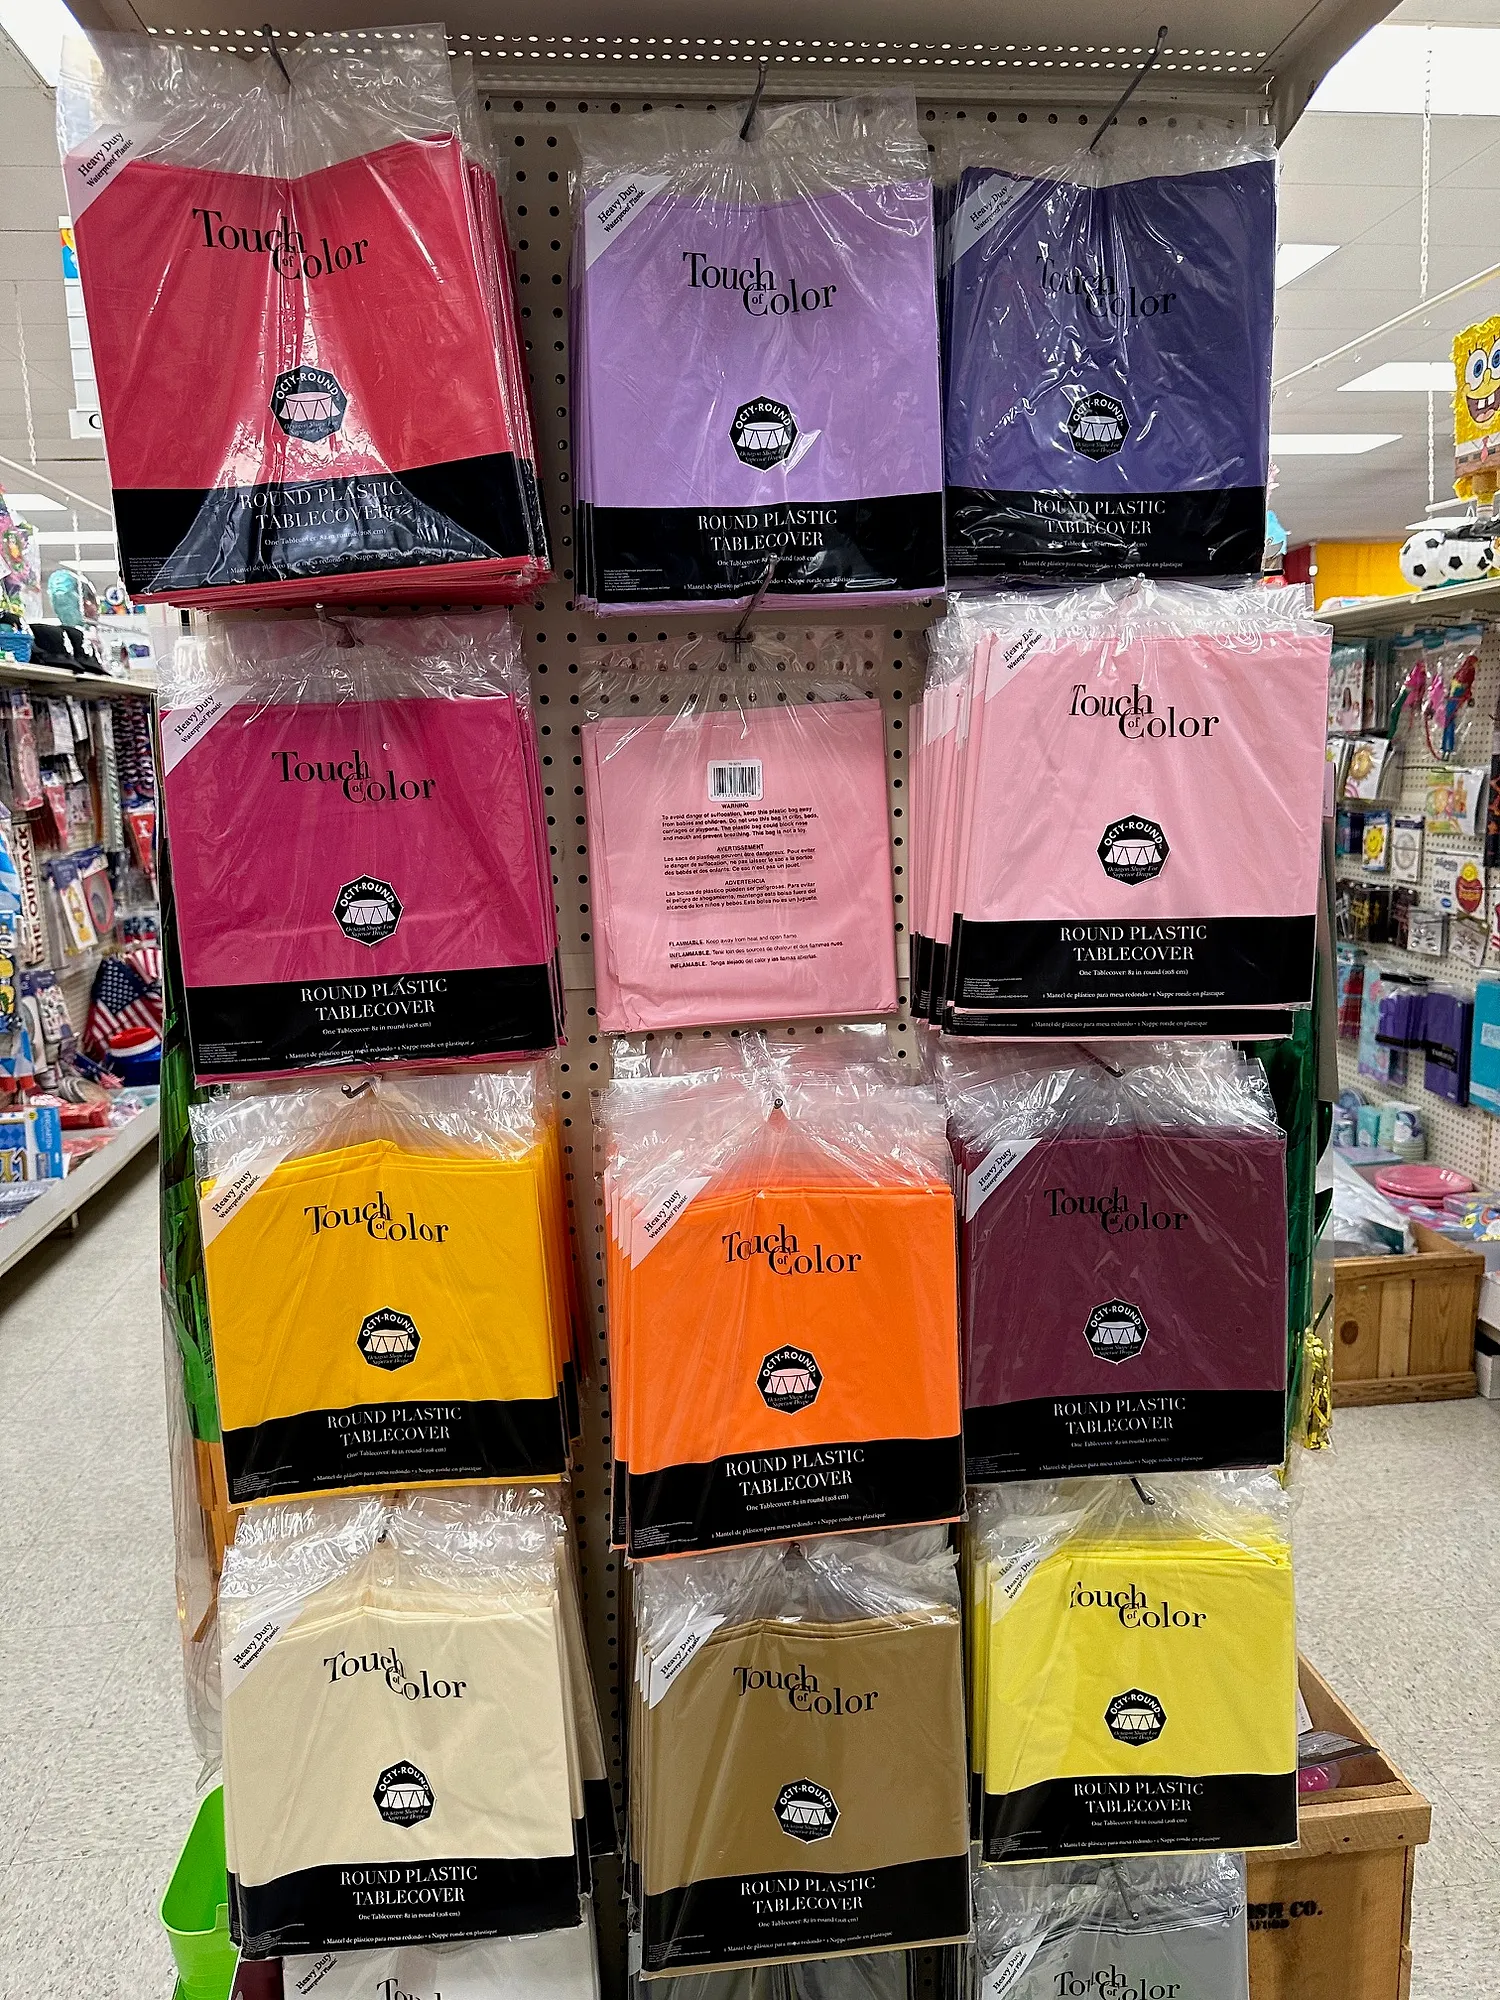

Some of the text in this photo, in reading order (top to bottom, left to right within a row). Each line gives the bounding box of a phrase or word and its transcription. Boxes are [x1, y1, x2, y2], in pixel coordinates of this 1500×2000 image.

[78, 132, 125, 177] Heavy Duty
[597, 183, 638, 224] Heavy Duty
[970, 201, 994, 223] Heavy
[192, 207, 306, 253] Touch
[272, 238, 369, 281] of Color
[682, 251, 777, 291] Touch
[743, 279, 836, 316] of Color
[1086, 286, 1176, 318] Color
[240, 481, 403, 509] ROUND PLASTIC
[1032, 500, 1166, 515] ROUND PLASTIC
[698, 510, 837, 531] ROUND PLASTIC
[1045, 520, 1151, 534] TABLECOVER
[710, 531, 824, 551] TABLECOVER
[1003, 641, 1024, 662] Heavy
[1068, 683, 1154, 717] Touch
[174, 694, 214, 736] Heavy Duty
[1118, 706, 1220, 739] of Color
[271, 750, 372, 782] Touch
[342, 770, 436, 803] of Color
[19, 826, 38, 918] OUTBACK
[724, 878, 766, 887] ADVERTENCIA
[1060, 925, 1207, 942] ROUND PLASTIC
[1073, 946, 1194, 962] TABLECOVER
[1143, 968, 1161, 976] round
[1175, 968, 1189, 977] cm)
[300, 978, 448, 1003] ROUND PLASTIC
[315, 1000, 436, 1021] TABLECOVER
[978, 1148, 1012, 1187] Heavy Duty
[211, 1170, 253, 1213] Heavy Duty
[1044, 1187, 1130, 1217] Touch
[304, 1190, 393, 1236] Touch
[643, 1190, 682, 1232] Heavy Duty
[1101, 1201, 1189, 1234] Color
[367, 1212, 449, 1243] of Color
[721, 1223, 800, 1263] Touch
[768, 1244, 862, 1275] of Color
[327, 1407, 461, 1429] ROUND PLASTIC
[1053, 1397, 1186, 1417] ROUND PLASTIC
[339, 1426, 450, 1446] TABLECOVER
[1065, 1416, 1173, 1435] TABLECOVER
[725, 1449, 865, 1477] ROUND PLASTIC
[739, 1469, 853, 1496] TABLECOVER
[1004, 1573, 1023, 1595] Heavy
[1119, 1601, 1207, 1629] of Color
[232, 1621, 274, 1665] Heavy Duty
[660, 1632, 697, 1675] Heavy Duty
[323, 1647, 407, 1684] Touch
[733, 1664, 820, 1696] Touch
[385, 1667, 467, 1701] Color
[789, 1687, 878, 1715] of Color
[1074, 1782, 1204, 1797] ROUND PLASTIC
[1085, 1799, 1191, 1814] TABLECOVER
[340, 1865, 478, 1886] ROUND PLASTIC
[741, 1876, 876, 1896] ROUND PLASTIC
[353, 1887, 465, 1905] TABLECOVER
[752, 1896, 863, 1914] TABLECOVER
[295, 1953, 332, 1990] Heavy Duty
[992, 1950, 1023, 1991] Heavy Duty
[1099, 1978, 1180, 2000] Color
